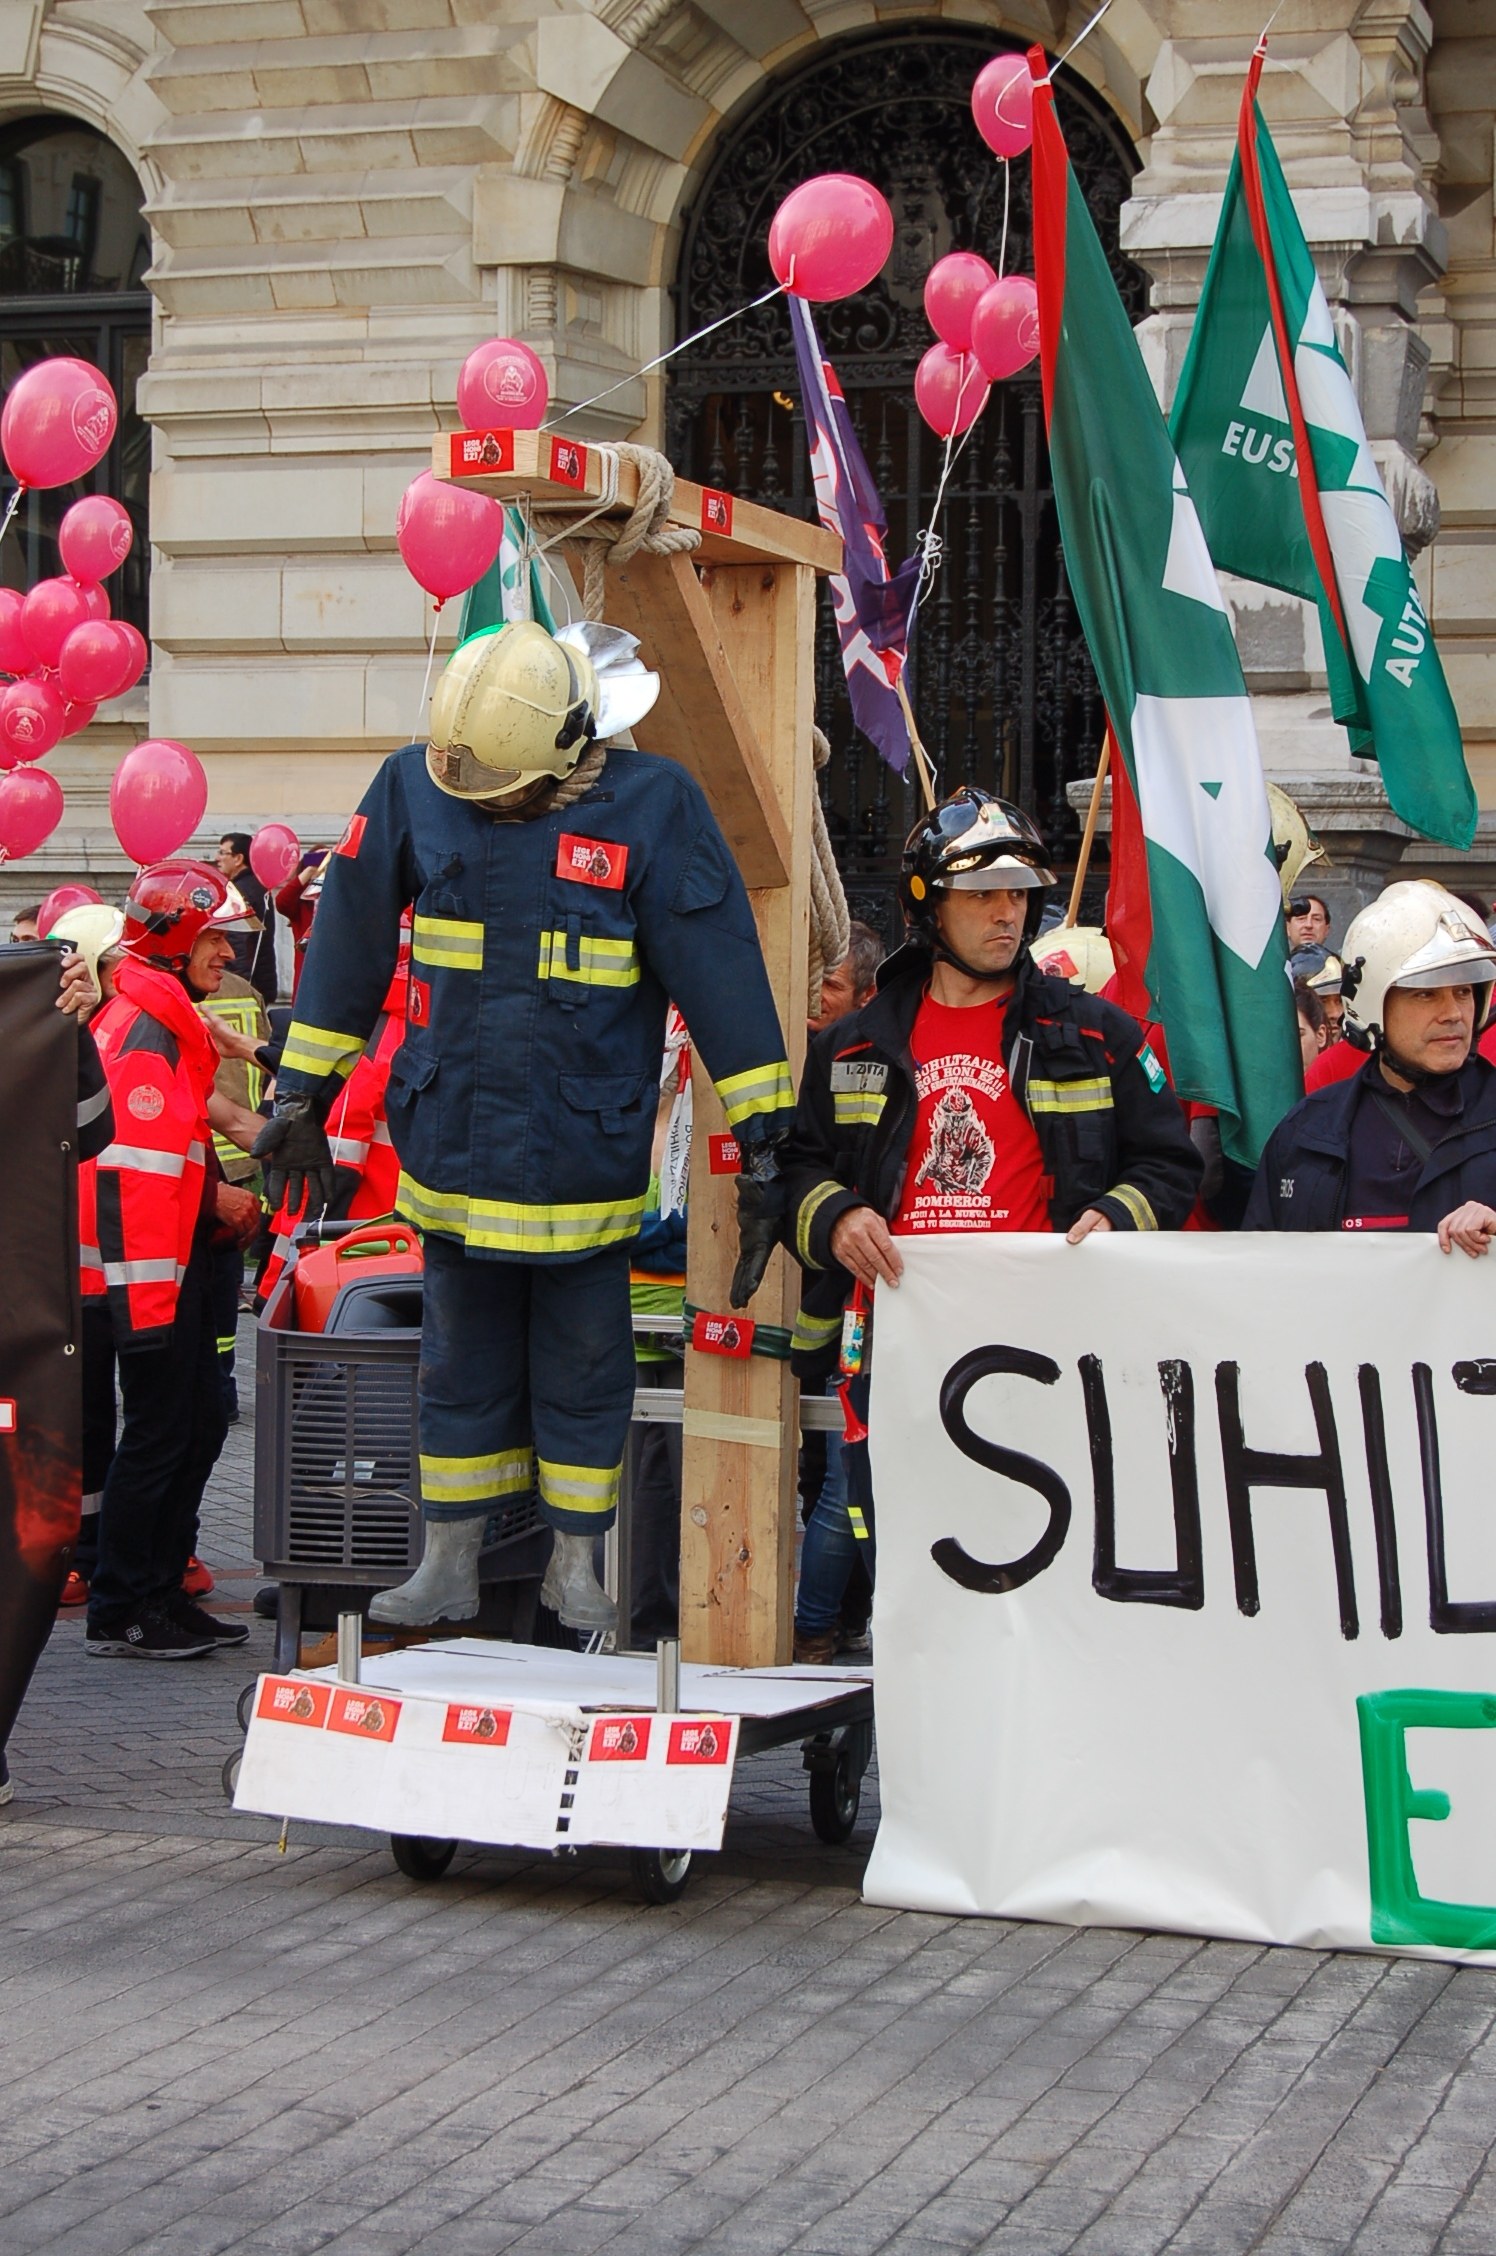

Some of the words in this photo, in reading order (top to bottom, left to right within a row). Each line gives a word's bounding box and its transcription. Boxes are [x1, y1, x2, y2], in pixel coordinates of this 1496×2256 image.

[914, 1054, 1006, 1081] SUHILTZAILE
[943, 1066, 976, 1078] HONI
[914, 1195, 992, 1209] BOMBEROS
[939, 1210, 952, 1218] LA
[955, 1210, 987, 1218] NUEVA
[990, 1210, 1009, 1218] LEY
[927, 1220, 937, 1228] TU
[930, 1344, 1496, 1641] SUHIL
